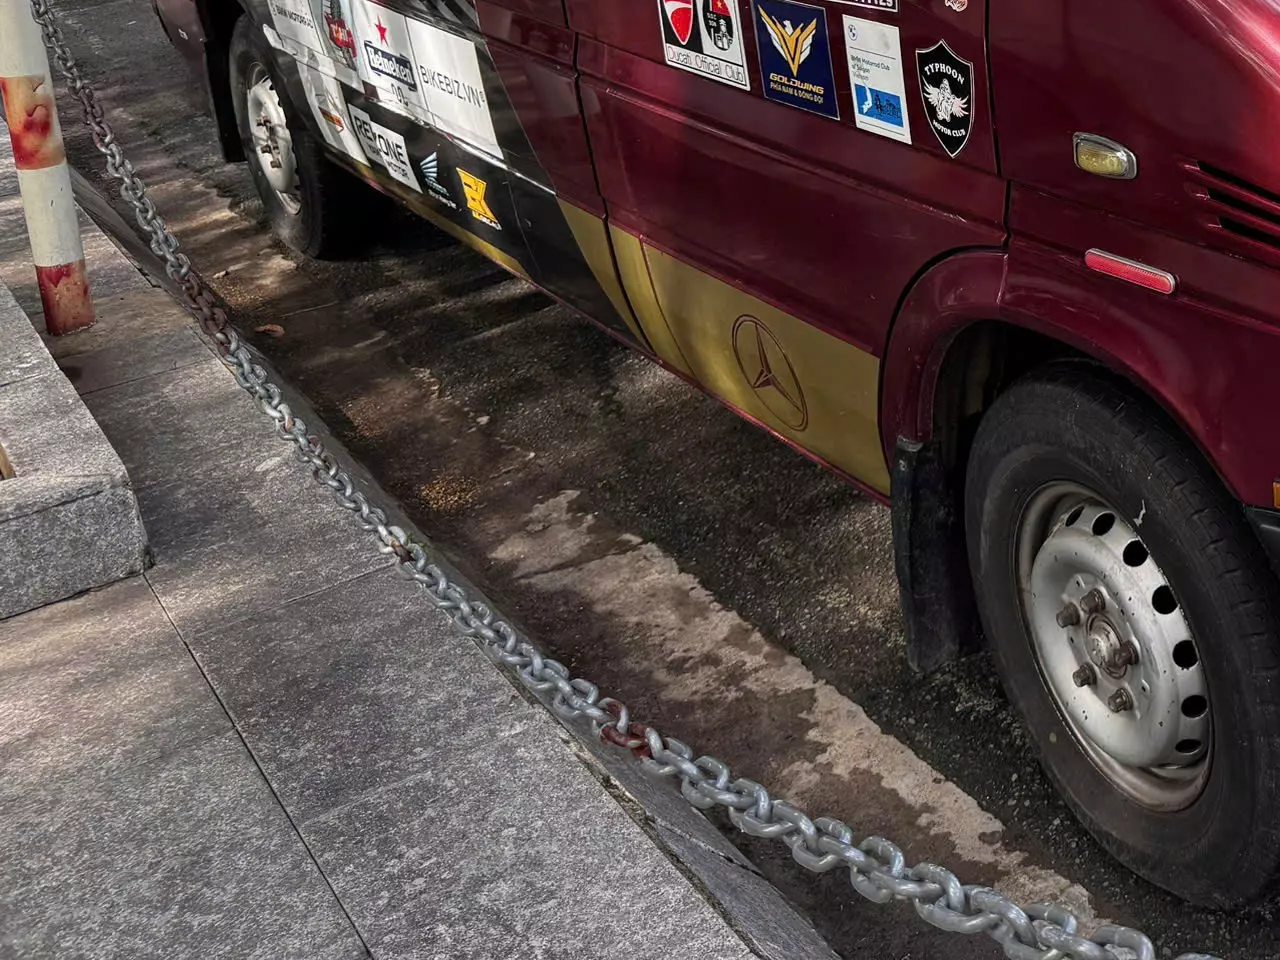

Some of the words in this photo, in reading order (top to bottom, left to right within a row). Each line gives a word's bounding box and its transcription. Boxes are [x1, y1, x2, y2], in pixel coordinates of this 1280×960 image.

[367, 45, 416, 86] Heineken
[924, 63, 965, 85] TYPHOON
[420, 65, 481, 108] BIKEBIZ.VN
[769, 72, 825, 95] GOLDWING
[932, 119, 952, 136] MOTOR
[952, 128, 966, 137] CLUB
